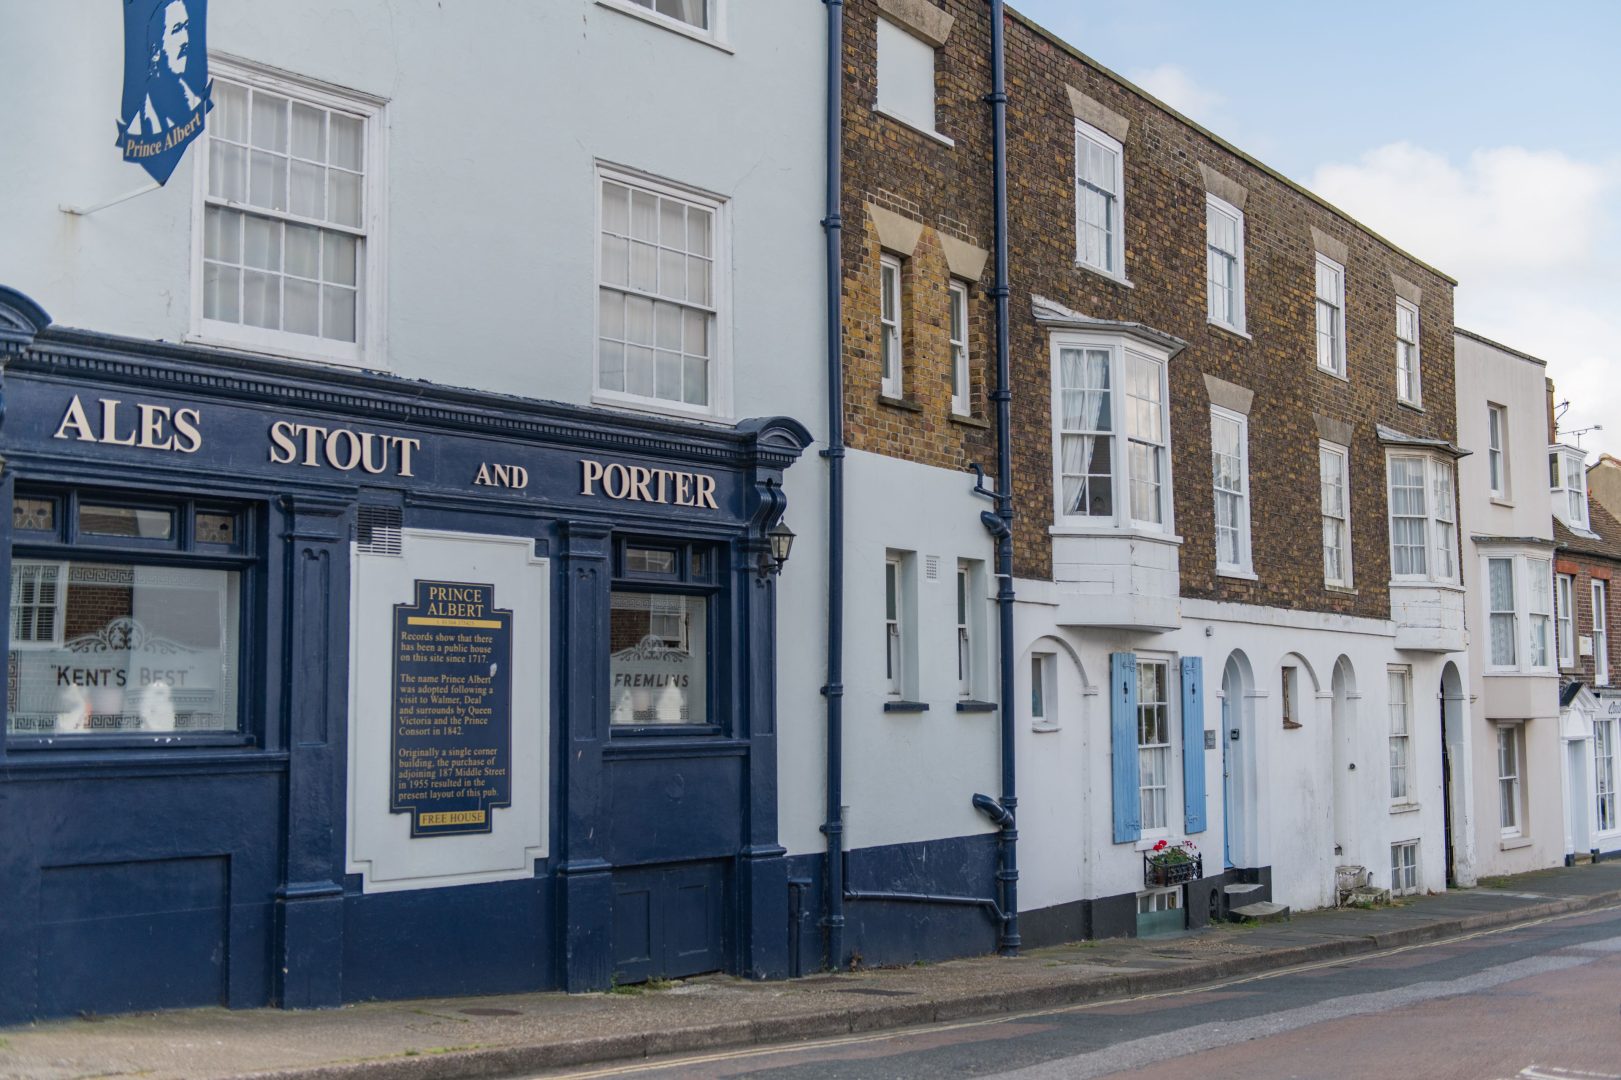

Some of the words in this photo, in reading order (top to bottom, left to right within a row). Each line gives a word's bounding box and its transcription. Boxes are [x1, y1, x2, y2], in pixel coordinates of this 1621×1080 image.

[126, 138, 162, 157] Prince
[163, 111, 201, 151] Albert
[53, 394, 202, 453] ALES
[270, 420, 421, 478] STOUT
[474, 462, 529, 489] AND
[579, 459, 719, 509] PORTER
[429, 586, 482, 603] PRINCE
[427, 602, 485, 618] ALBERT
[401, 631, 433, 641] Records
[435, 633, 455, 642] show
[457, 633, 472, 643] that
[474, 634, 493, 643] there
[400, 642, 414, 651] has
[417, 642, 435, 652] been
[444, 644, 468, 655] public
[470, 644, 492, 654] house
[400, 654, 411, 662] on
[413, 653, 428, 662] this
[429, 653, 444, 662] site
[446, 654, 466, 663] since
[400, 673, 416, 683] The
[441, 674, 466, 684] Prince
[467, 675, 491, 684] Albert
[614, 673, 690, 687] FREMLINS
[417, 684, 449, 696] adopted
[450, 684, 487, 697] following
[400, 695, 418, 704] visit
[420, 696, 428, 704] to
[464, 695, 482, 704] Deal
[399, 705, 414, 715] and
[415, 706, 454, 715] surrounds
[456, 706, 466, 717] by
[468, 706, 492, 717] Queen
[400, 716, 432, 725] Victoria
[433, 716, 448, 725] and
[450, 716, 462, 725] the
[464, 716, 488, 725] Prince
[398, 726, 431, 736] Consort
[432, 726, 441, 735] in
[398, 747, 440, 758] Originally
[448, 747, 472, 758] single
[473, 748, 498, 756] corner
[437, 758, 449, 767] the
[451, 757, 485, 768] purchase
[487, 756, 496, 766] of
[398, 769, 436, 780] adjoining
[455, 768, 482, 777] Middle
[484, 767, 506, 776] Street
[398, 780, 407, 790] in
[409, 779, 429, 789] 1955
[430, 778, 462, 788] resulted
[464, 778, 472, 787] in
[473, 777, 486, 787] the
[398, 791, 428, 802] present
[429, 789, 454, 801] layout
[456, 788, 465, 798] of
[466, 787, 481, 797] this
[422, 813, 448, 825] FREE
[450, 811, 484, 824] HOUSE
